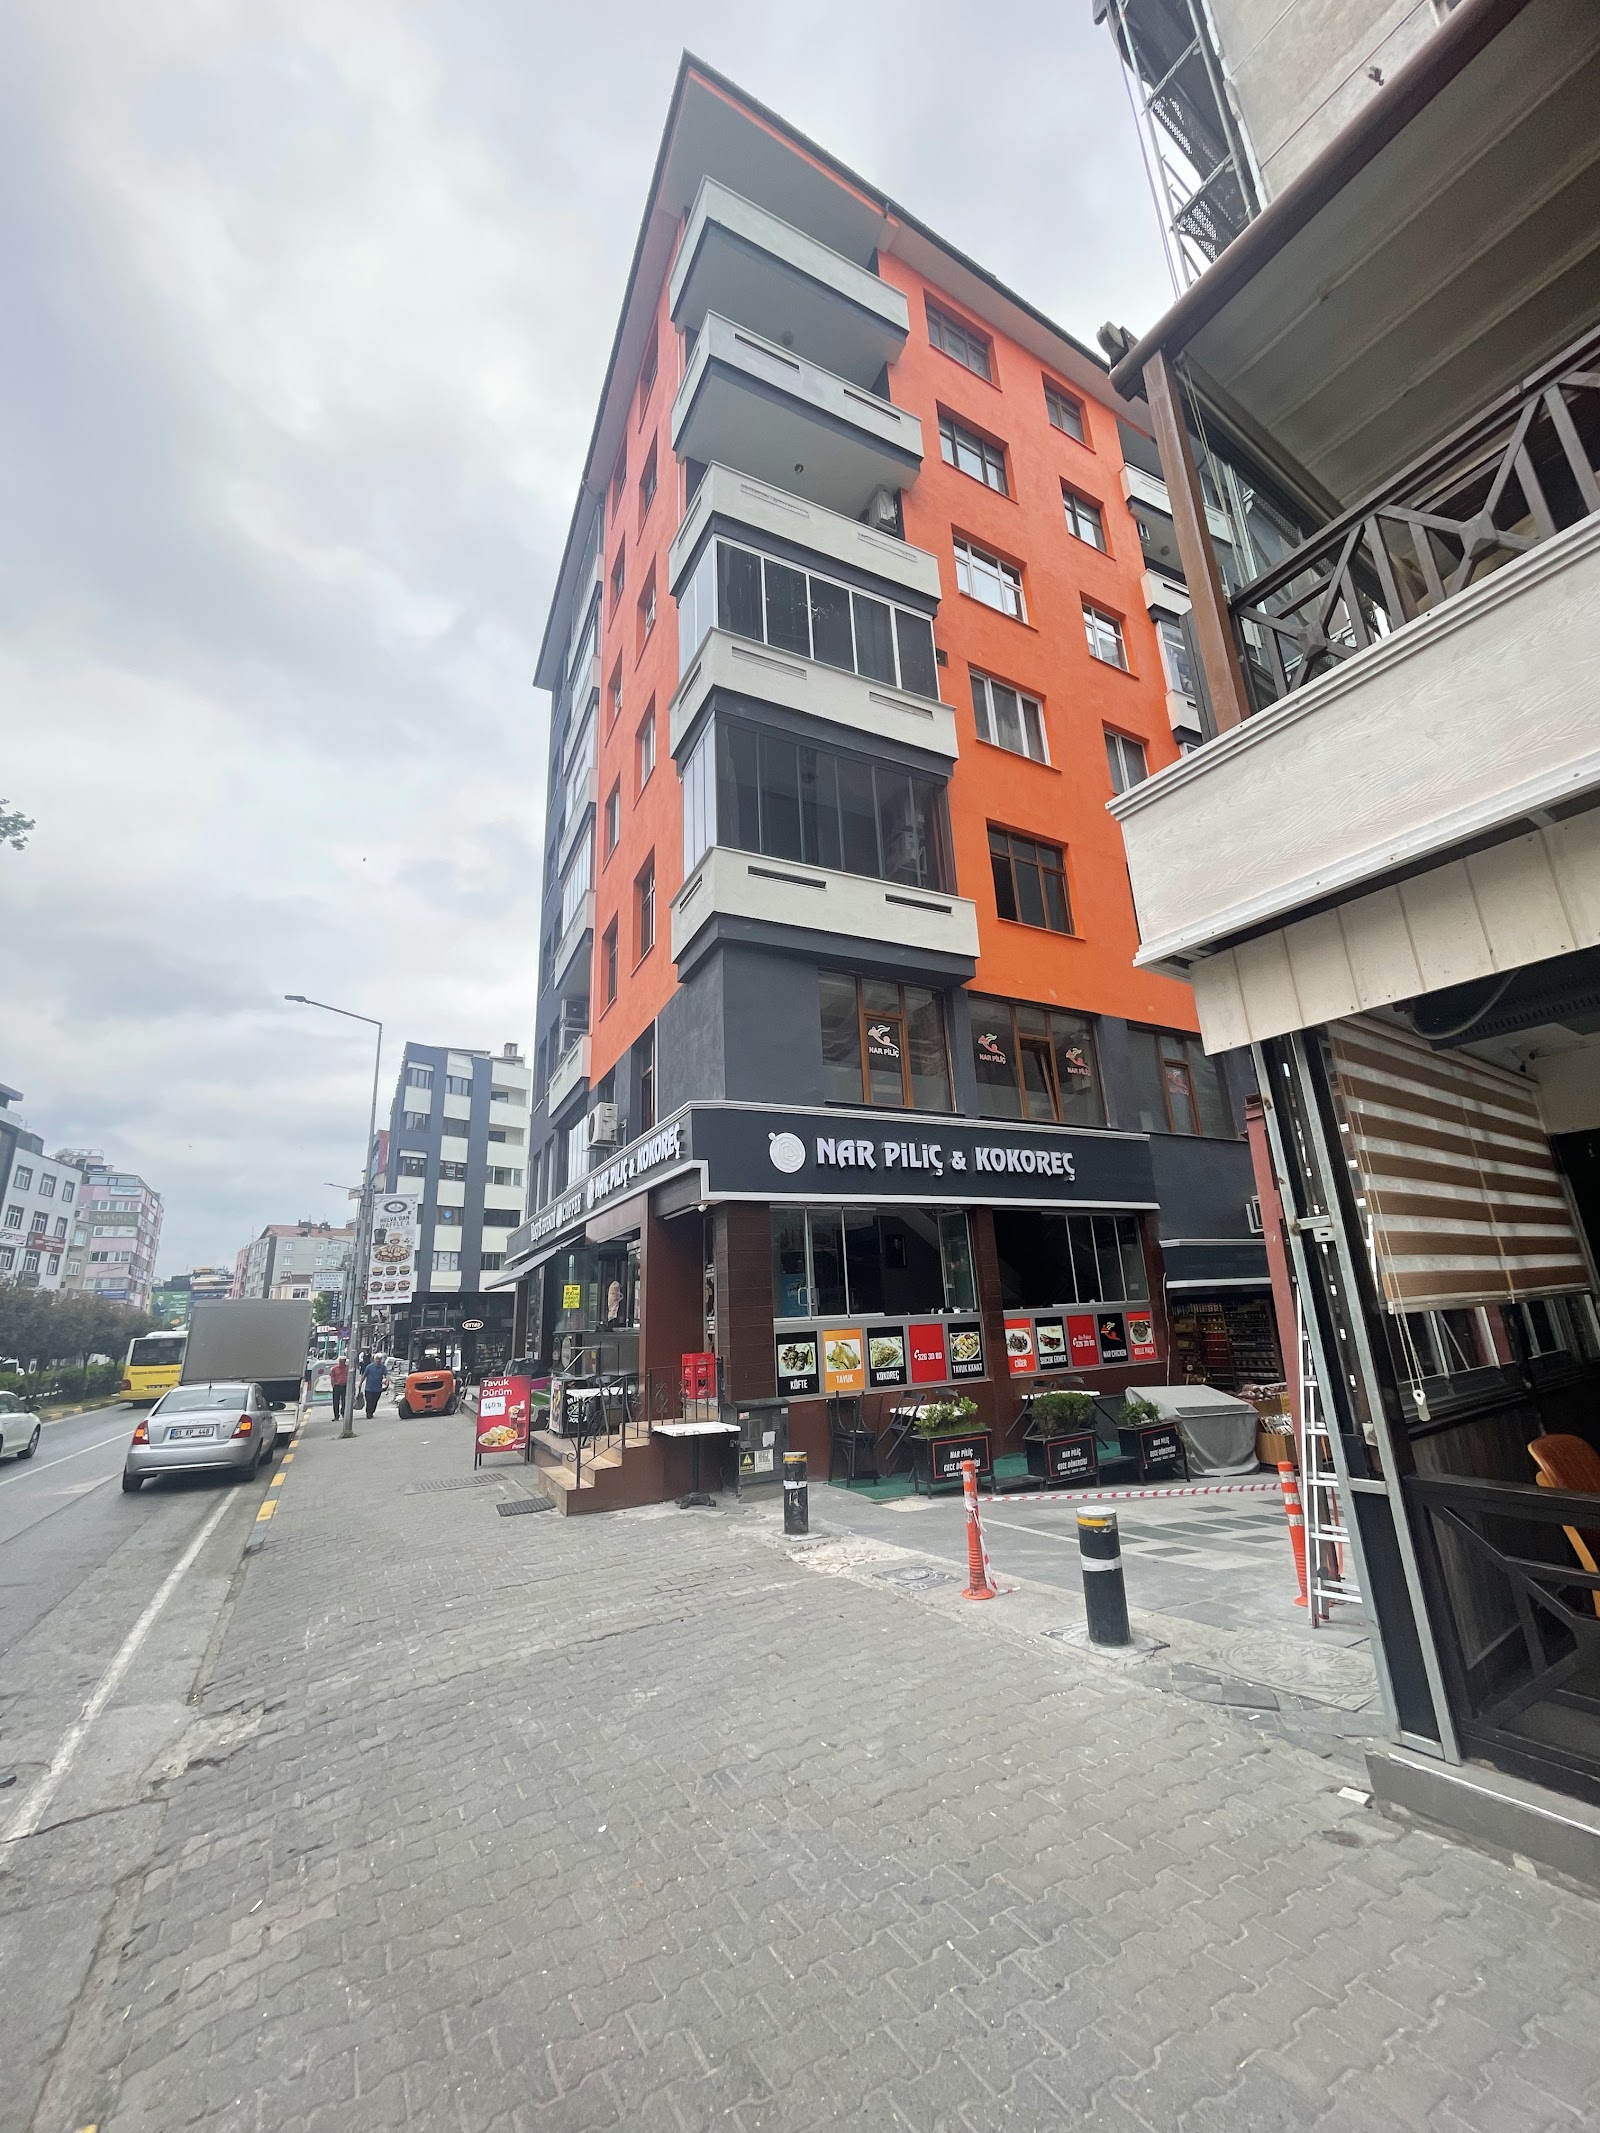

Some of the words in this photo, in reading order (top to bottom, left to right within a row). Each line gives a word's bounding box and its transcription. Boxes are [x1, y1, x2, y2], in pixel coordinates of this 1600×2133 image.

[868, 1046, 883, 1055] NAR
[883, 1047, 900, 1059] PİLİÇ
[979, 1053, 992, 1062] NAR
[992, 1054, 1006, 1065] PİLİÇ
[1067, 1066, 1078, 1075] NAR
[595, 1170, 609, 1199] NAR
[637, 1122, 680, 1174] KOKOREÇ
[816, 1137, 877, 1170] NAR
[884, 1141, 944, 1177] PİLİÇ
[951, 1150, 968, 1171] &
[974, 1146, 1076, 1182] KOKOREÇ
[562, 1192, 582, 1222] COFFEE
[1111, 1349, 1127, 1358] CHICKEN
[1039, 1355, 1054, 1365] SUCUK
[1054, 1354, 1067, 1363] EKMEK
[952, 1364, 968, 1374] TAVUK
[968, 1363, 982, 1372] KANAT
[836, 1374, 854, 1384] TAVUK
[876, 1370, 900, 1381] KOKOREÇ
[483, 1379, 509, 1387] Tavuk
[790, 1379, 808, 1390] KÖFTE
[482, 1388, 512, 1397] Dürüm
[174, 1429, 182, 1437] 61
[950, 1450, 960, 1459] NAR
[961, 1448, 973, 1458] PİLİÇ
[1062, 1450, 1070, 1458] NAR
[944, 1462, 956, 1472] GECE
[1057, 1462, 1067, 1470] GECE
